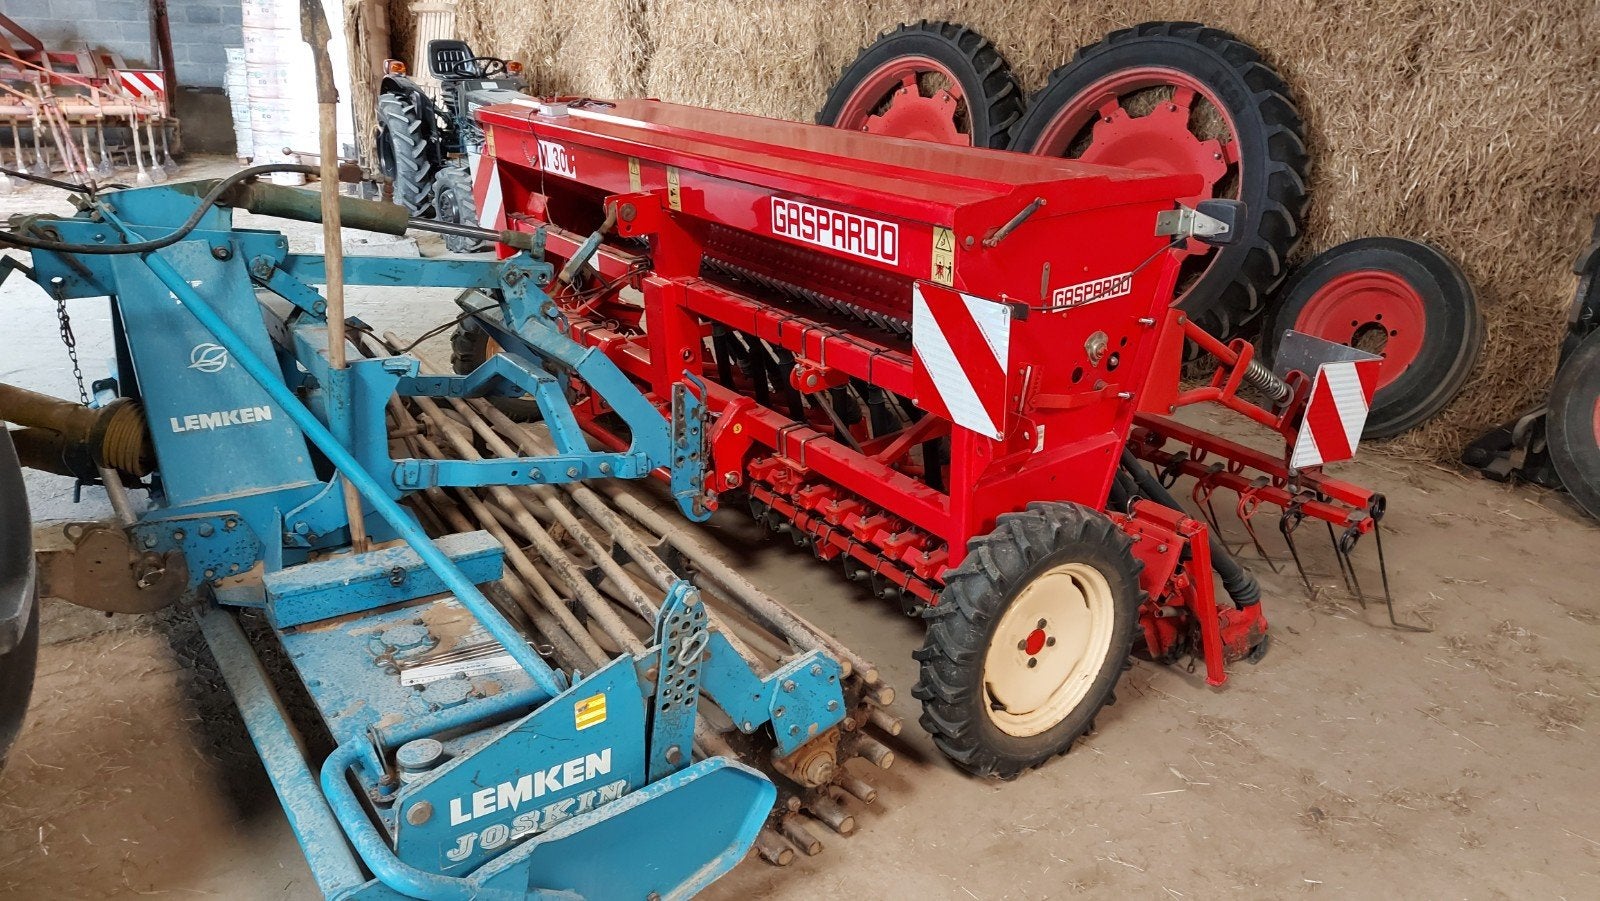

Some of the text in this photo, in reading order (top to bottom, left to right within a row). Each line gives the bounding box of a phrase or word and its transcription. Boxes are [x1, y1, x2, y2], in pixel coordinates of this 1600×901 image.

[773, 198, 897, 262] GASPARDO
[1054, 274, 1130, 308] GASPARDO
[170, 405, 273, 433] LEMKEN
[449, 747, 612, 827] LEMKEN
[446, 778, 627, 862] JOSKIN
